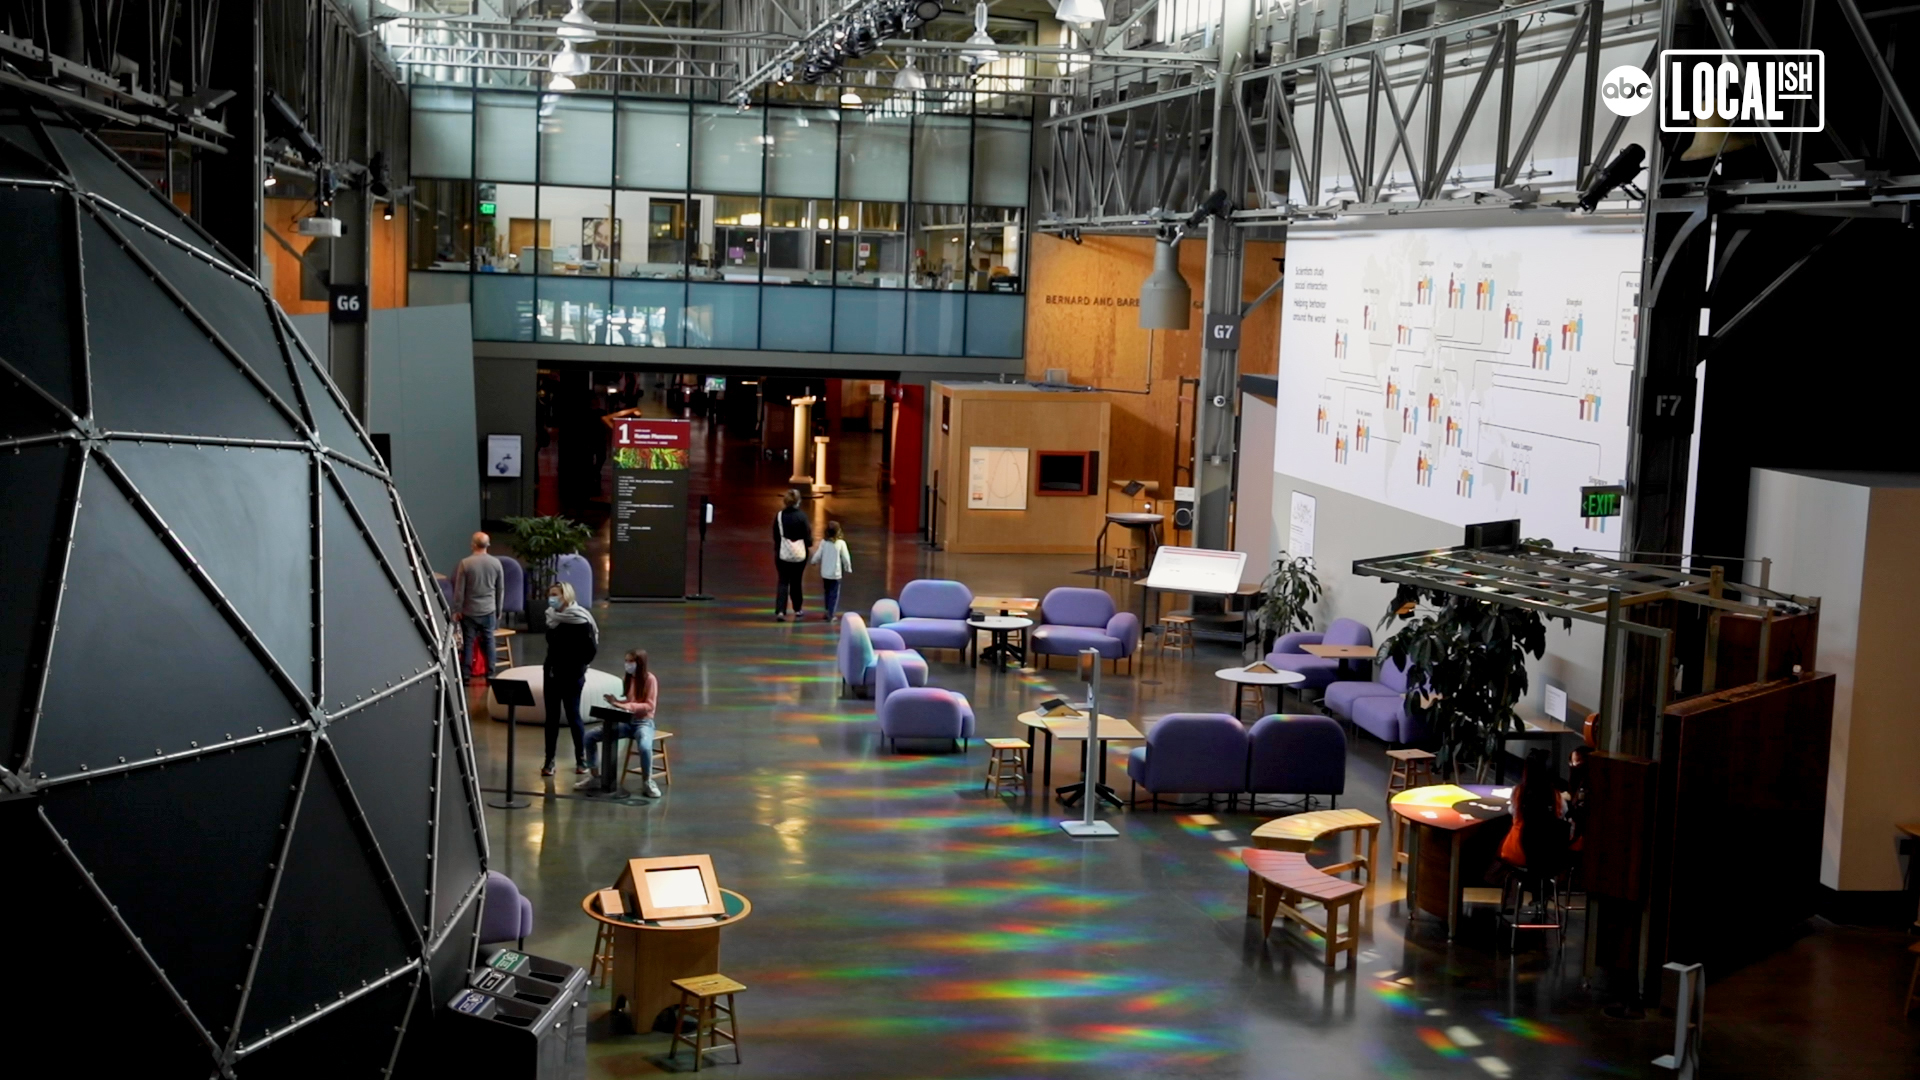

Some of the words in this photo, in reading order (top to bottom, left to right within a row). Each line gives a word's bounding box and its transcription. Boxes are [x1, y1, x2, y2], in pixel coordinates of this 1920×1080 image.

[336, 295, 361, 311] G6
[1045, 294, 1090, 306] BERNARD
[1093, 296, 1113, 307] AND
[1213, 324, 1234, 340] G7
[1656, 394, 1682, 417] F7
[618, 423, 631, 445] 1
[1587, 493, 1616, 516] EXIT
